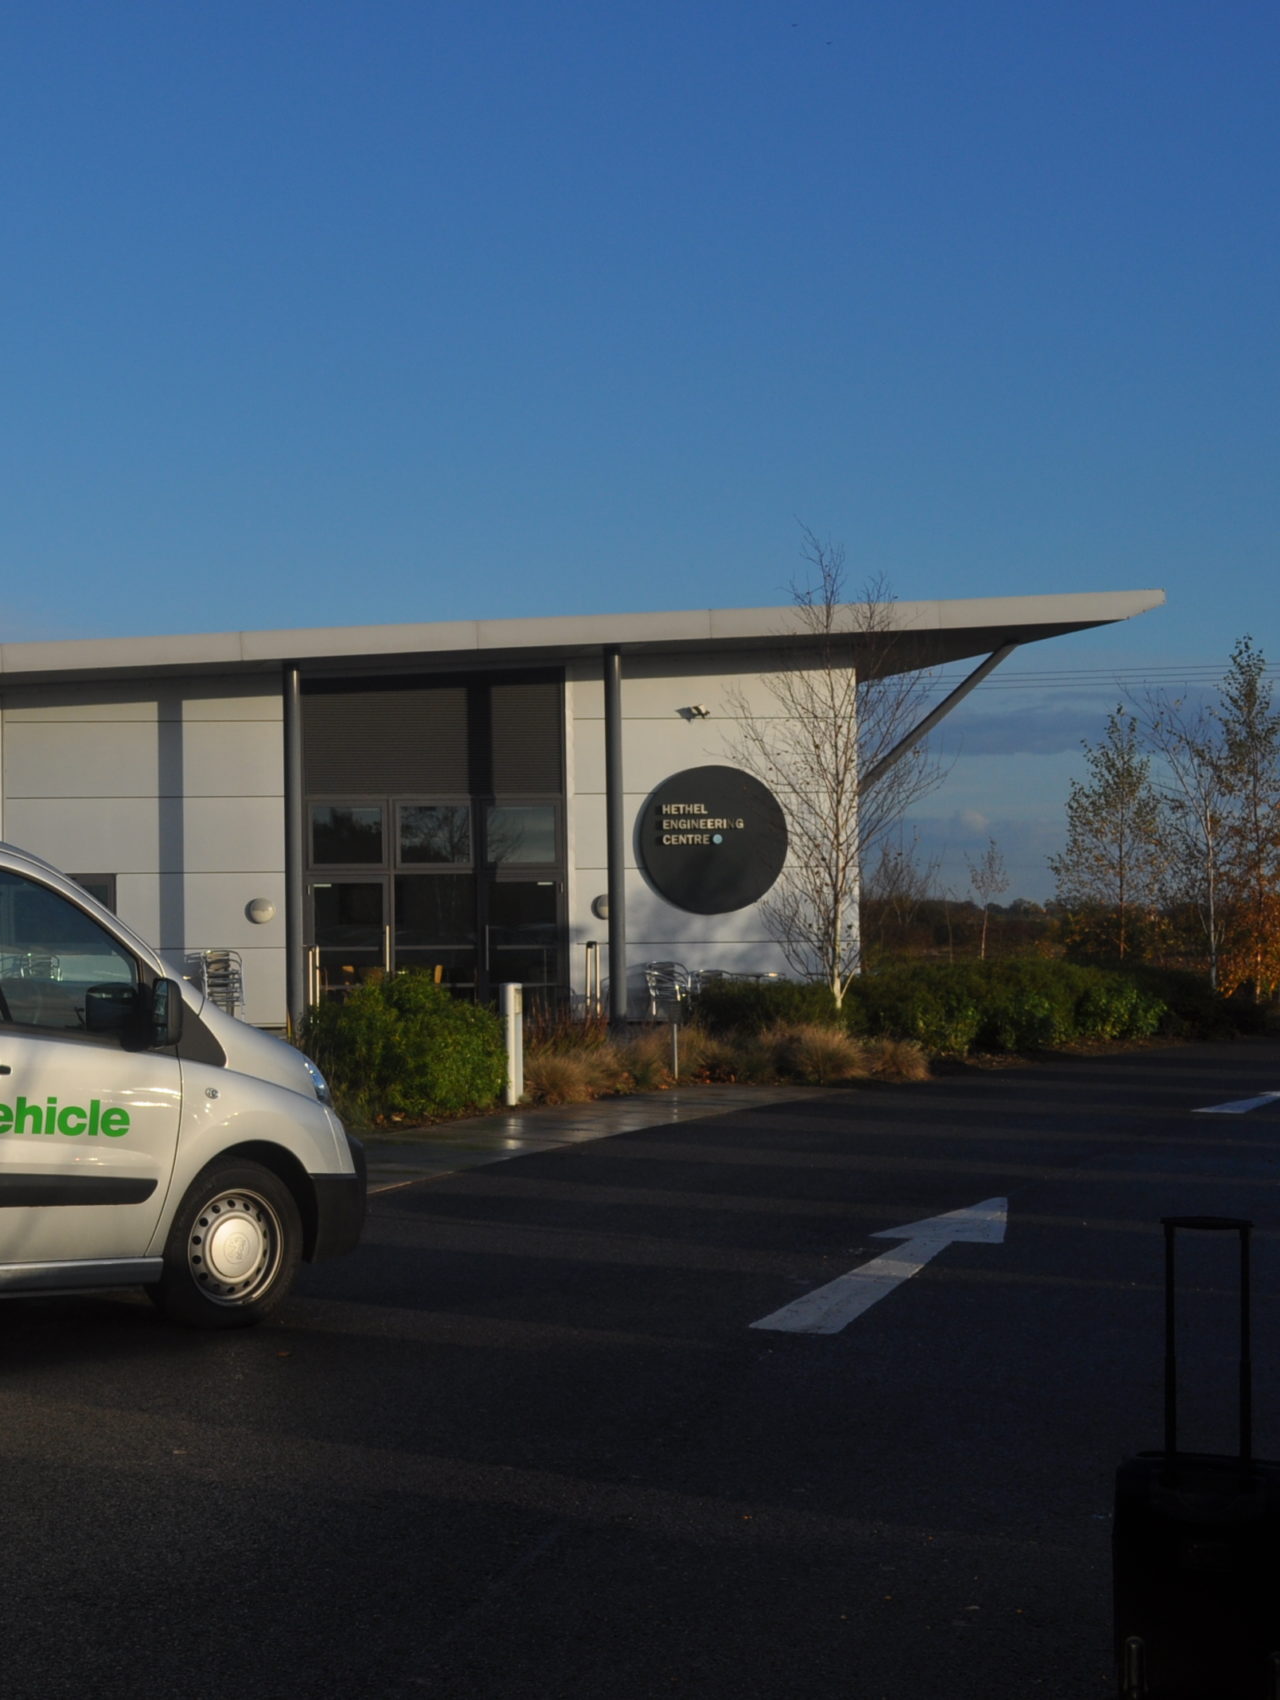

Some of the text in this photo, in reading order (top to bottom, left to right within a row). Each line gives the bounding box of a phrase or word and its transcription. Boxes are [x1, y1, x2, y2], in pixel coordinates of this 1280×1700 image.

[662, 804, 708, 815] HETHEL
[662, 818, 745, 830] ENGINEERING
[662, 833, 711, 845] CENTRE
